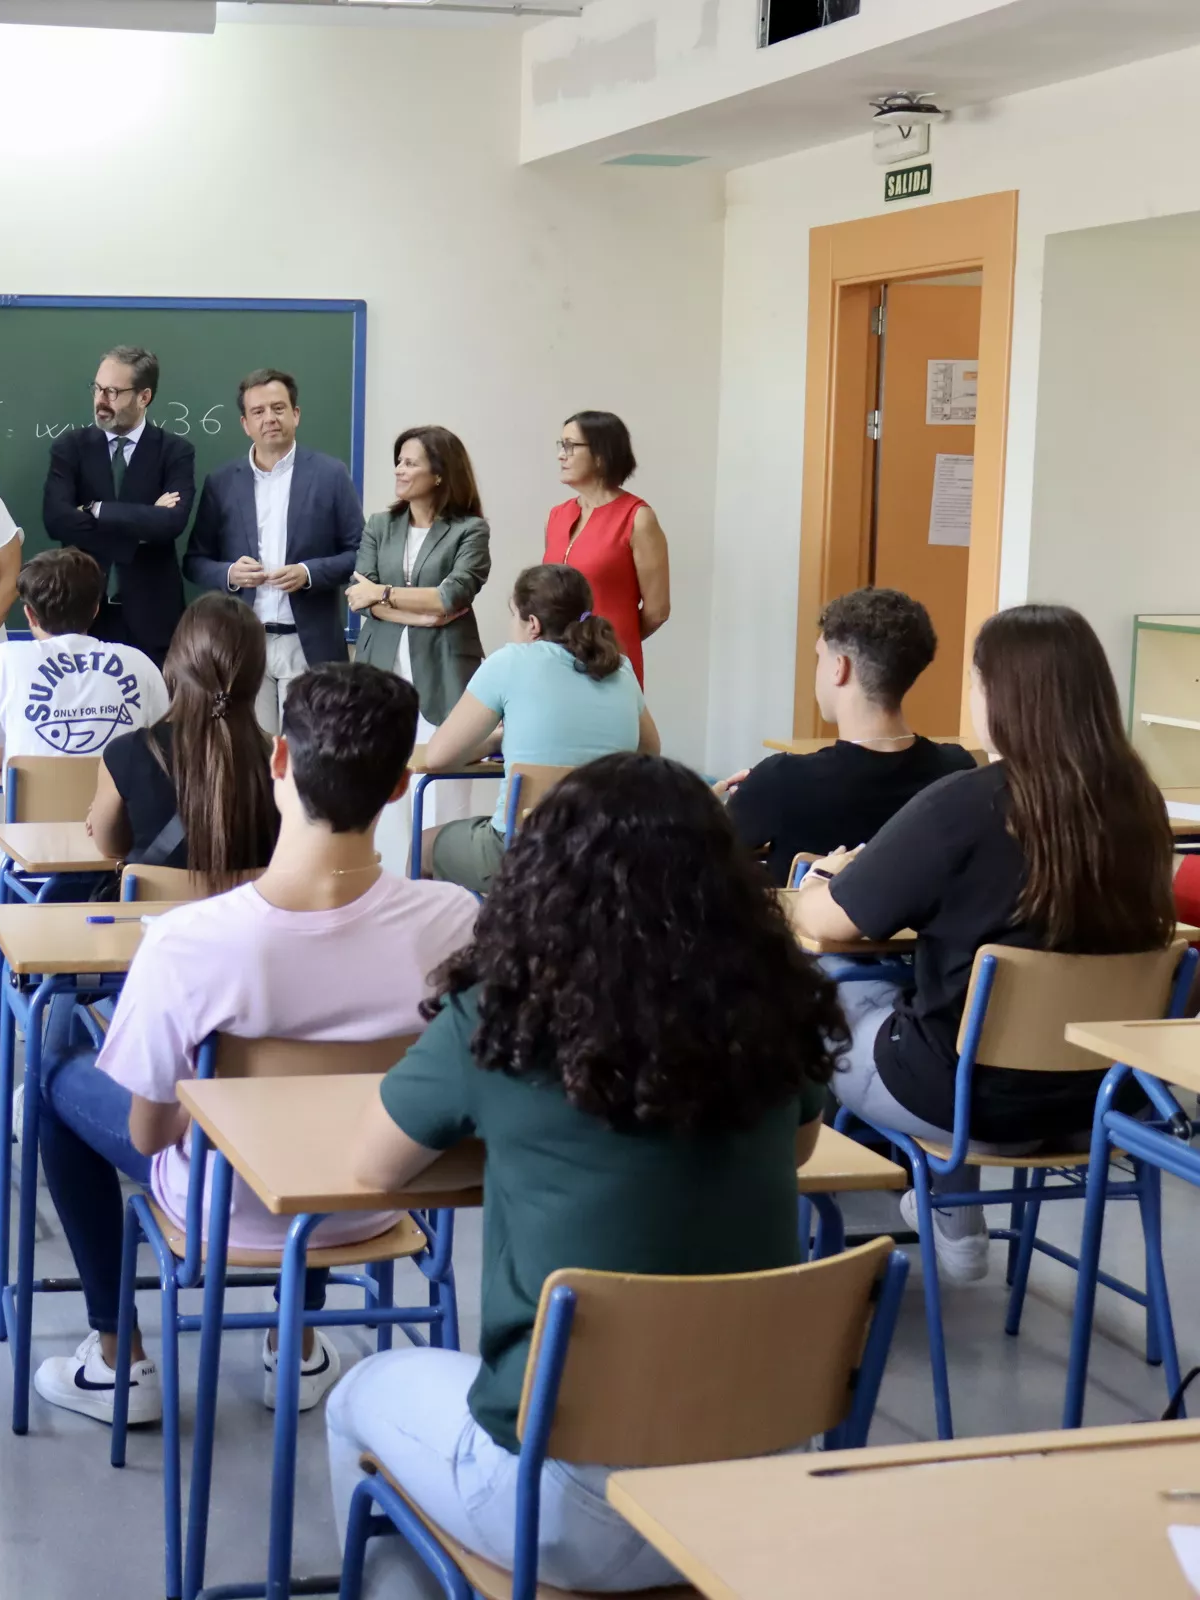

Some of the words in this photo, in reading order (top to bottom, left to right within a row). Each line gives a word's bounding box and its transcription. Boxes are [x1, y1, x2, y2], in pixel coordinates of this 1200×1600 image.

[887, 169, 928, 197] SALIDA
[53, 709, 77, 718] ONLY
[80, 707, 97, 717] FOR
[100, 704, 119, 714] FISH
